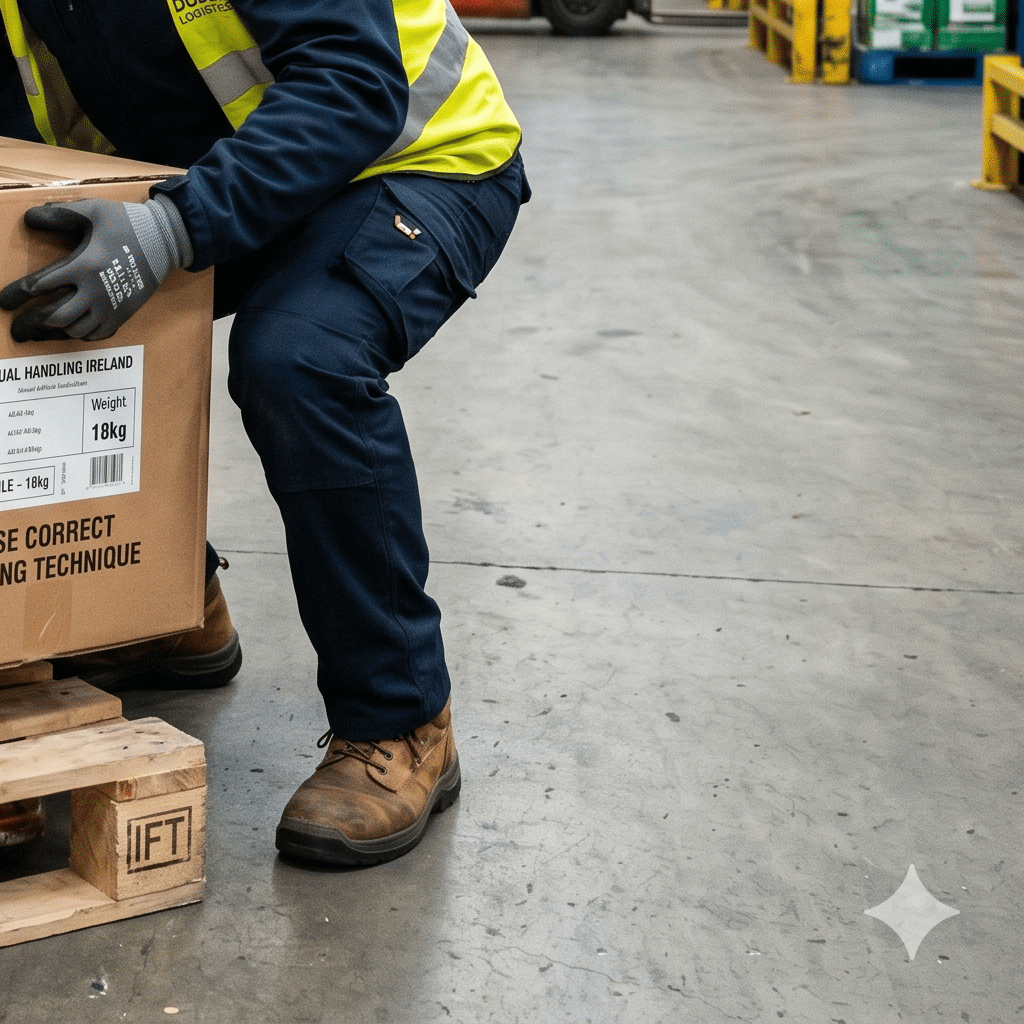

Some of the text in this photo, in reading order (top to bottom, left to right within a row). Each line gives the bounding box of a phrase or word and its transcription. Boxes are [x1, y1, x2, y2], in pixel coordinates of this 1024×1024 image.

[24, 360, 83, 380] HANDLING
[86, 355, 134, 374] IRELAND
[91, 395, 127, 412] Weight
[91, 422, 127, 442] 18kg
[25, 475, 50, 490] 18kg
[25, 513, 116, 550] CORRECT
[33, 541, 142, 581] TECHNIQUE
[134, 815, 185, 863] IFT
